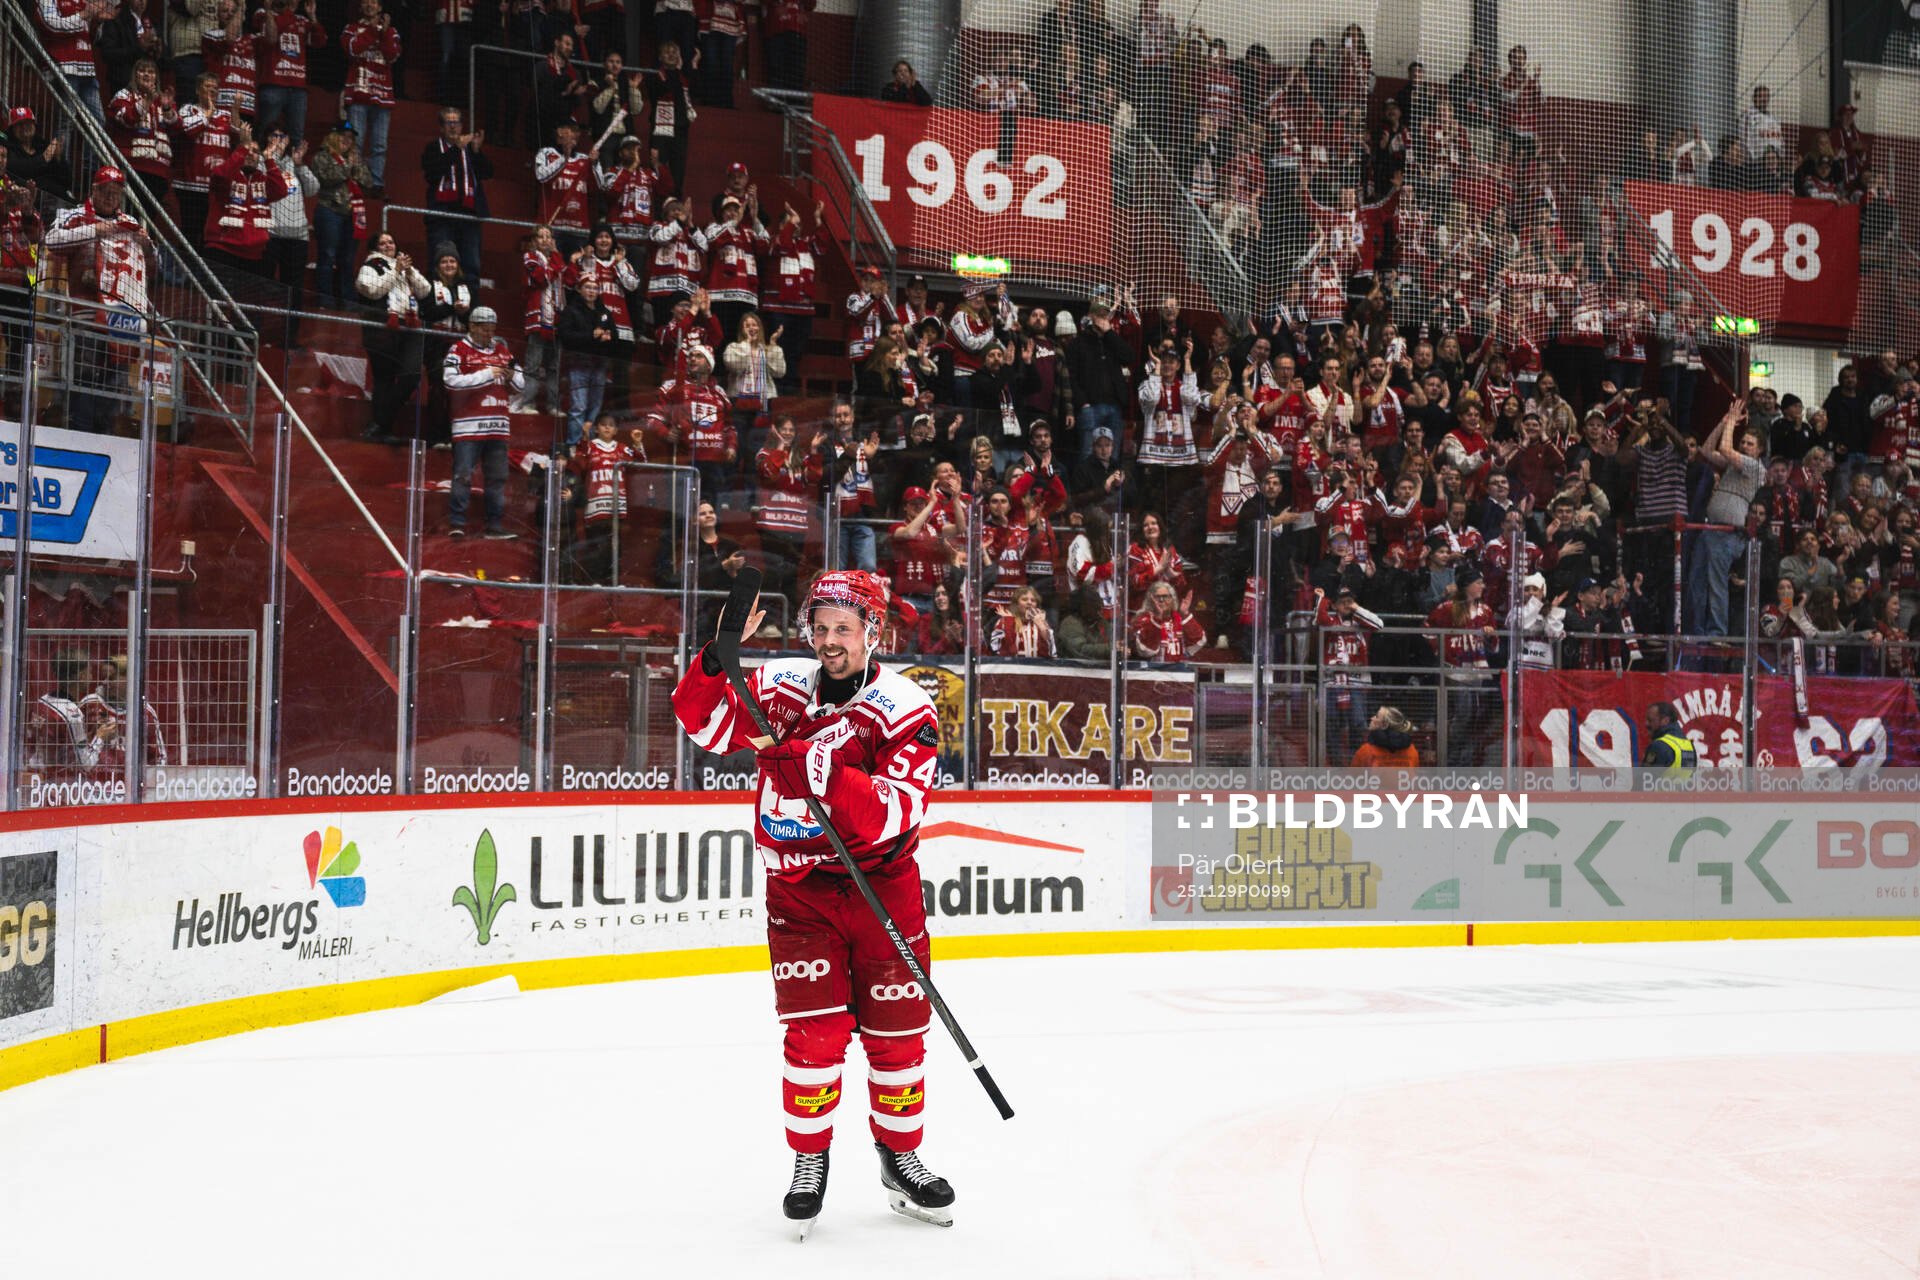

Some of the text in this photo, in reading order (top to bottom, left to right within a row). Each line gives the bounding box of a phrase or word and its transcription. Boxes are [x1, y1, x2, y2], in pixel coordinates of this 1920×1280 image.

[855, 134, 1067, 220] 1962
[1650, 209, 1822, 282] 1928
[784, 670, 808, 688] SCA
[875, 695, 896, 713] SCA
[1673, 683, 1732, 729] IMRÅ
[981, 698, 1194, 763] TIKARE
[1539, 708, 1634, 792] 19
[424, 766, 530, 793] Brandcode
[562, 764, 669, 790] Brandcode
[888, 745, 938, 789] 54
[988, 768, 1100, 787] Brandcode
[1132, 769, 1247, 790] Brandcode
[1270, 769, 1381, 791] Brandcode
[31, 772, 126, 807] Brandcode
[156, 770, 257, 802] Brandcode
[288, 767, 392, 796] Brandcode
[770, 822, 810, 838] TIMRÅ IK
[530, 829, 754, 910] LILIUM
[926, 865, 1084, 917] dium
[1876, 886, 1906, 898] BYGG
[172, 892, 318, 951] Hellbergs
[531, 908, 753, 932] FASTIGHETER
[298, 934, 353, 960] MÅLERI
[774, 958, 831, 982] coop
[797, 1092, 836, 1104] SUNDFRAKT
[881, 1094, 921, 1104] SUNDFRAKT
